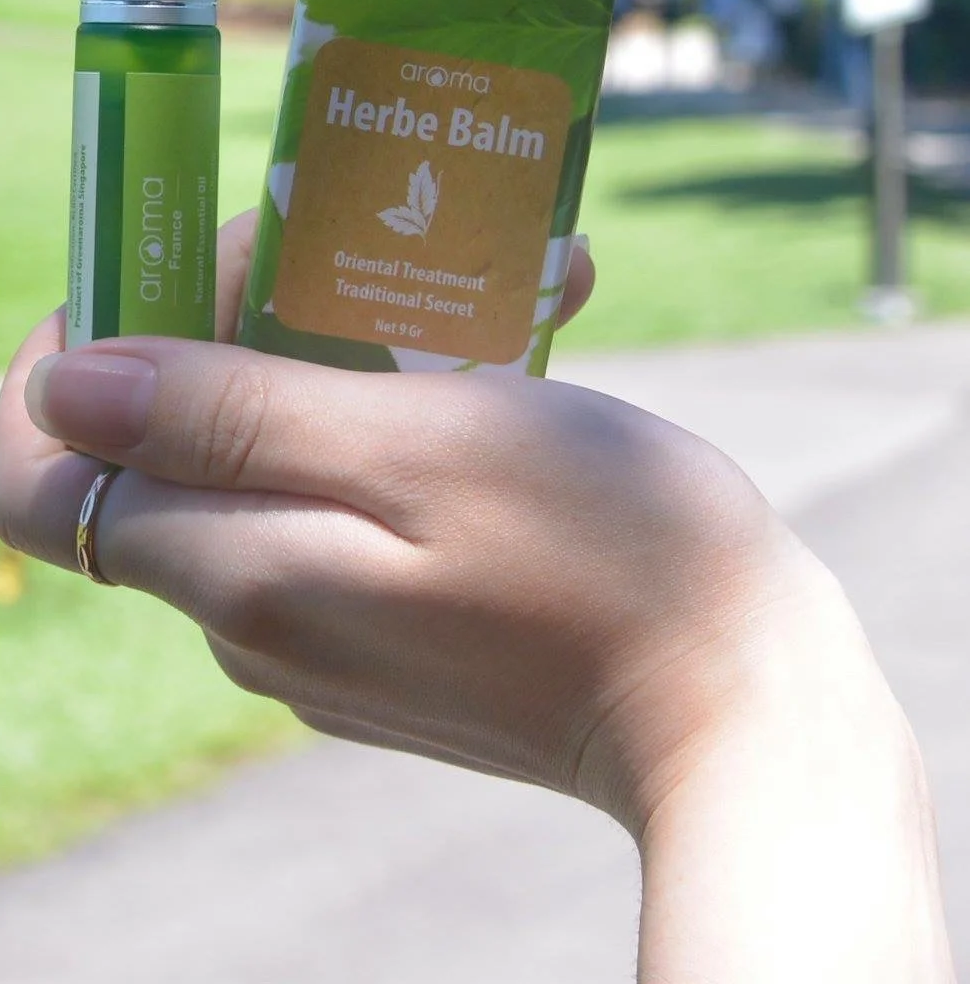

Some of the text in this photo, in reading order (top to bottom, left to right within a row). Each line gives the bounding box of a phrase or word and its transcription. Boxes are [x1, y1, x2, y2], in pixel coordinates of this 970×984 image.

[401, 62, 490, 94] aroma
[326, 87, 545, 160] Herbe Balm
[78, 144, 87, 201] Singapore
[139, 176, 165, 302] aroma
[168, 209, 183, 270] France
[195, 196, 207, 254] Essential
[76, 271, 83, 283] of
[194, 256, 205, 304] Natural
[334, 250, 486, 291] Oriental Treatment
[74, 286, 83, 328] Product
[335, 278, 476, 318] Traditional Secret
[375, 318, 424, 338] Net 9 Gr
